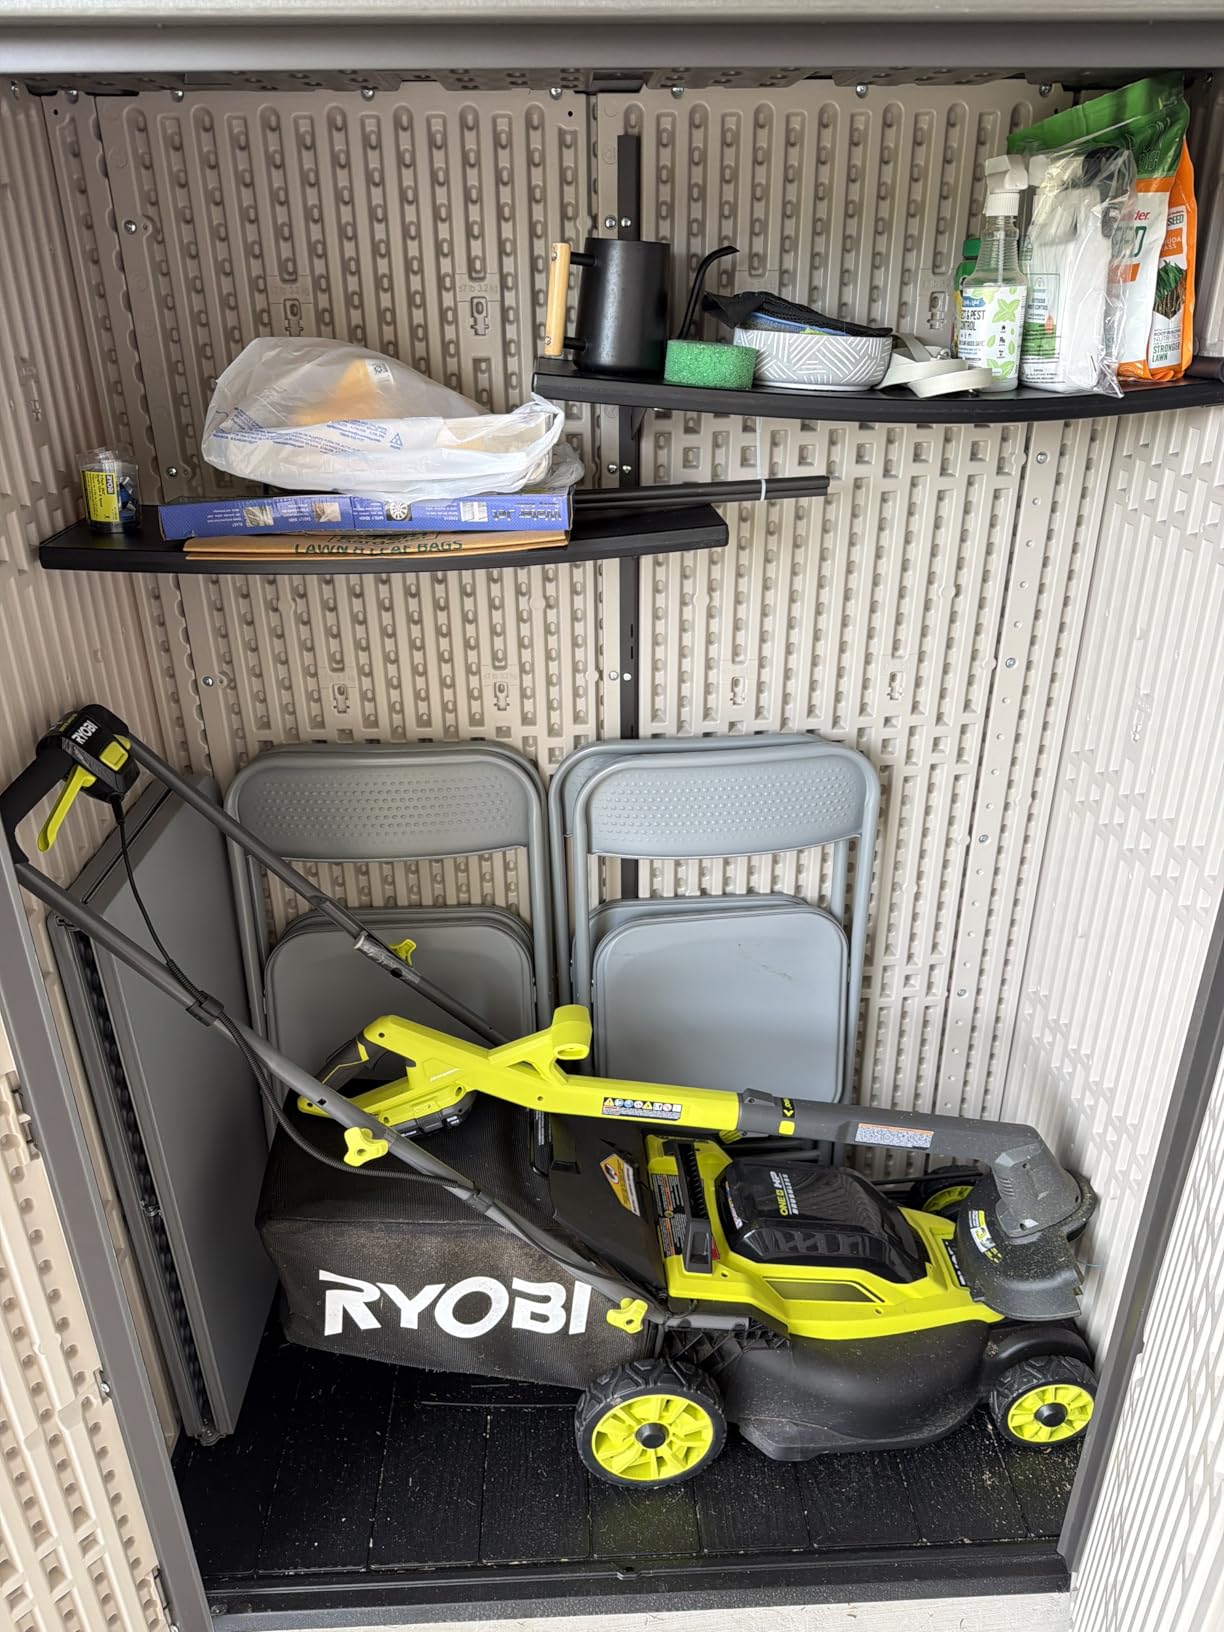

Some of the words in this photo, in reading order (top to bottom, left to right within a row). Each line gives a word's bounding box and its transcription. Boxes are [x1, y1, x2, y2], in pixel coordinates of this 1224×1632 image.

[970, 310, 986, 321] PEST
[1152, 353, 1168, 363] LAWN
[106, 475, 114, 493] RYOBI
[417, 540, 463, 553] BAGS
[71, 719, 98, 745] RYOBI
[769, 1171, 782, 1188] HP
[318, 1269, 593, 1339] RYOBI
